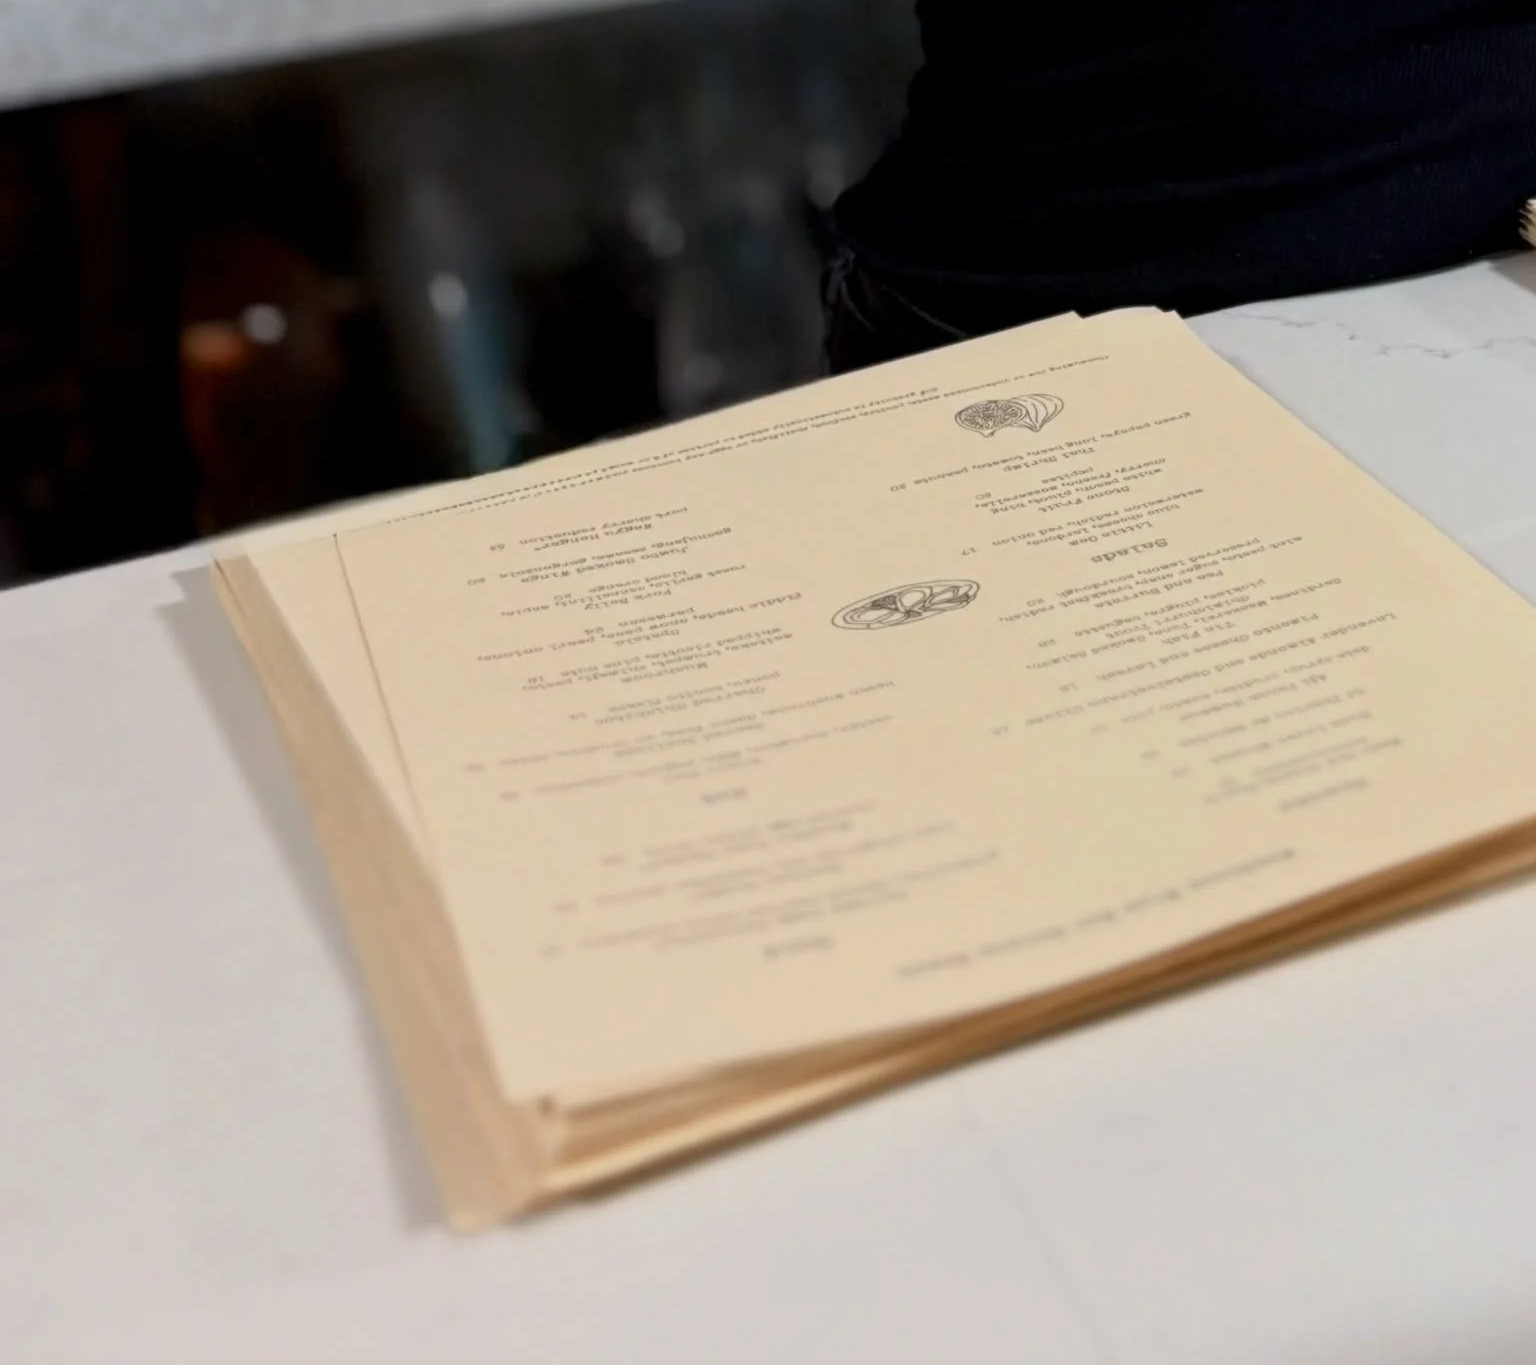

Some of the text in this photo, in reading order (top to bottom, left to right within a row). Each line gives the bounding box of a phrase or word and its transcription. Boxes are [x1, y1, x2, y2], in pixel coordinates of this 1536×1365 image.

[1154, 412, 1191, 425] green
[1101, 423, 1151, 438] papaya,
[1027, 446, 1063, 456] bean,
[1065, 437, 1097, 447] long
[972, 455, 1024, 469] tomato,
[1003, 447, 1096, 471] Thai Shrimp
[914, 467, 968, 484] peanuts
[975, 458, 1165, 508] cherry, fresno, mozzarella,
[1042, 467, 1093, 483] pepitas
[991, 469, 1162, 514] white peach, pluot, bing
[1038, 486, 1130, 512] Stone Fruit
[519, 507, 688, 544] port cherry reduction
[604, 524, 652, 536] Wagyu
[962, 489, 1203, 556] watermelon radish, red onion 17
[1027, 504, 1180, 545] blue cheese, lardons,
[651, 527, 731, 548] gochujang,
[1069, 521, 1152, 545] Little Gem
[592, 547, 646, 560] sesame,
[1091, 538, 1168, 563] Salads
[1189, 538, 1260, 563] preserved
[499, 558, 586, 578] gorgonzola
[521, 547, 688, 583] Jumbo Smoked Wings
[707, 565, 746, 577] roast
[1137, 560, 1185, 574] lemon,
[589, 580, 640, 592] orange
[645, 570, 687, 583] blood
[647, 573, 702, 587] garlic,
[999, 536, 1302, 621] mint pesto, sugar snap, breakfast radish,
[1056, 574, 1134, 598] sourdough
[1095, 570, 1224, 608] Pea and Burrata
[1204, 579, 1265, 599] pickles,
[585, 589, 671, 610] Pork Belly
[477, 592, 802, 661] fiddle heads, snow peas, pearl onions,
[619, 607, 694, 627] parmesan
[1026, 578, 1342, 669] Sardines, Mackerel, Tuna, Smoked Salmon,
[1074, 616, 1141, 636] baguette
[1106, 596, 1249, 638] Chimichurri Trout
[1321, 613, 1396, 639] Lavender
[716, 628, 782, 646] whipped
[725, 633, 792, 650] maitake,
[1162, 622, 1235, 644] Tin Fish
[645, 643, 711, 659] ricotta,
[1097, 613, 1319, 681] Pimento Cheese and Lavash
[1249, 637, 1316, 660] Almonds
[604, 656, 640, 668] pine
[652, 650, 721, 667] trumpet,
[1214, 659, 1244, 672] and
[561, 666, 598, 677] nuts
[621, 662, 708, 683] Mushroom
[727, 671, 780, 686] ponzu,
[522, 678, 573, 690] pesto,
[667, 686, 723, 700] bonito
[1088, 669, 1211, 707] Castelvetrano
[608, 698, 661, 712] flakes
[693, 686, 765, 707] Charred
[1026, 705, 1084, 726] Olives
[1180, 699, 1245, 721] Hummus
